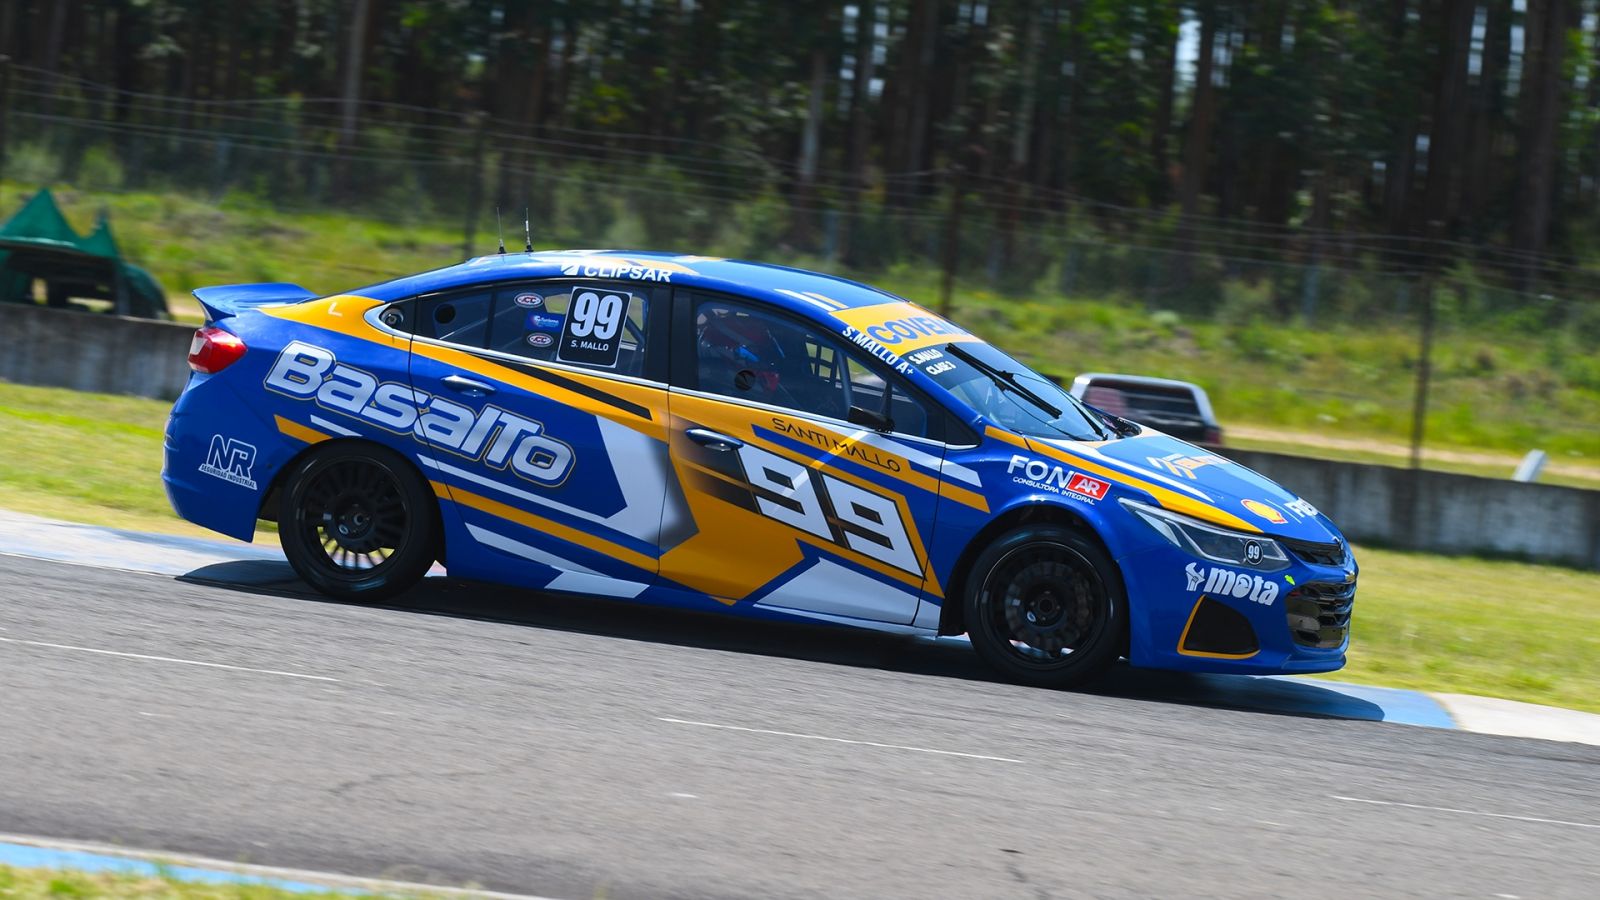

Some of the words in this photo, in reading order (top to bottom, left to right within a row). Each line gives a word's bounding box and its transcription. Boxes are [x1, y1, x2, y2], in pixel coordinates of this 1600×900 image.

[584, 263, 673, 283] CLIPSAR
[570, 291, 623, 340] 99
[571, 340, 579, 348] S.
[580, 341, 609, 352] MALLO
[206, 434, 257, 480] NR
[772, 417, 829, 447] SANTI
[832, 439, 901, 472] MALLO
[1012, 476, 1059, 493] CONSULTORA
[1061, 490, 1095, 506] INTEGRAL
[738, 449, 926, 580] 99
[1247, 544, 1260, 560] 99
[1203, 567, 1280, 606] mota
